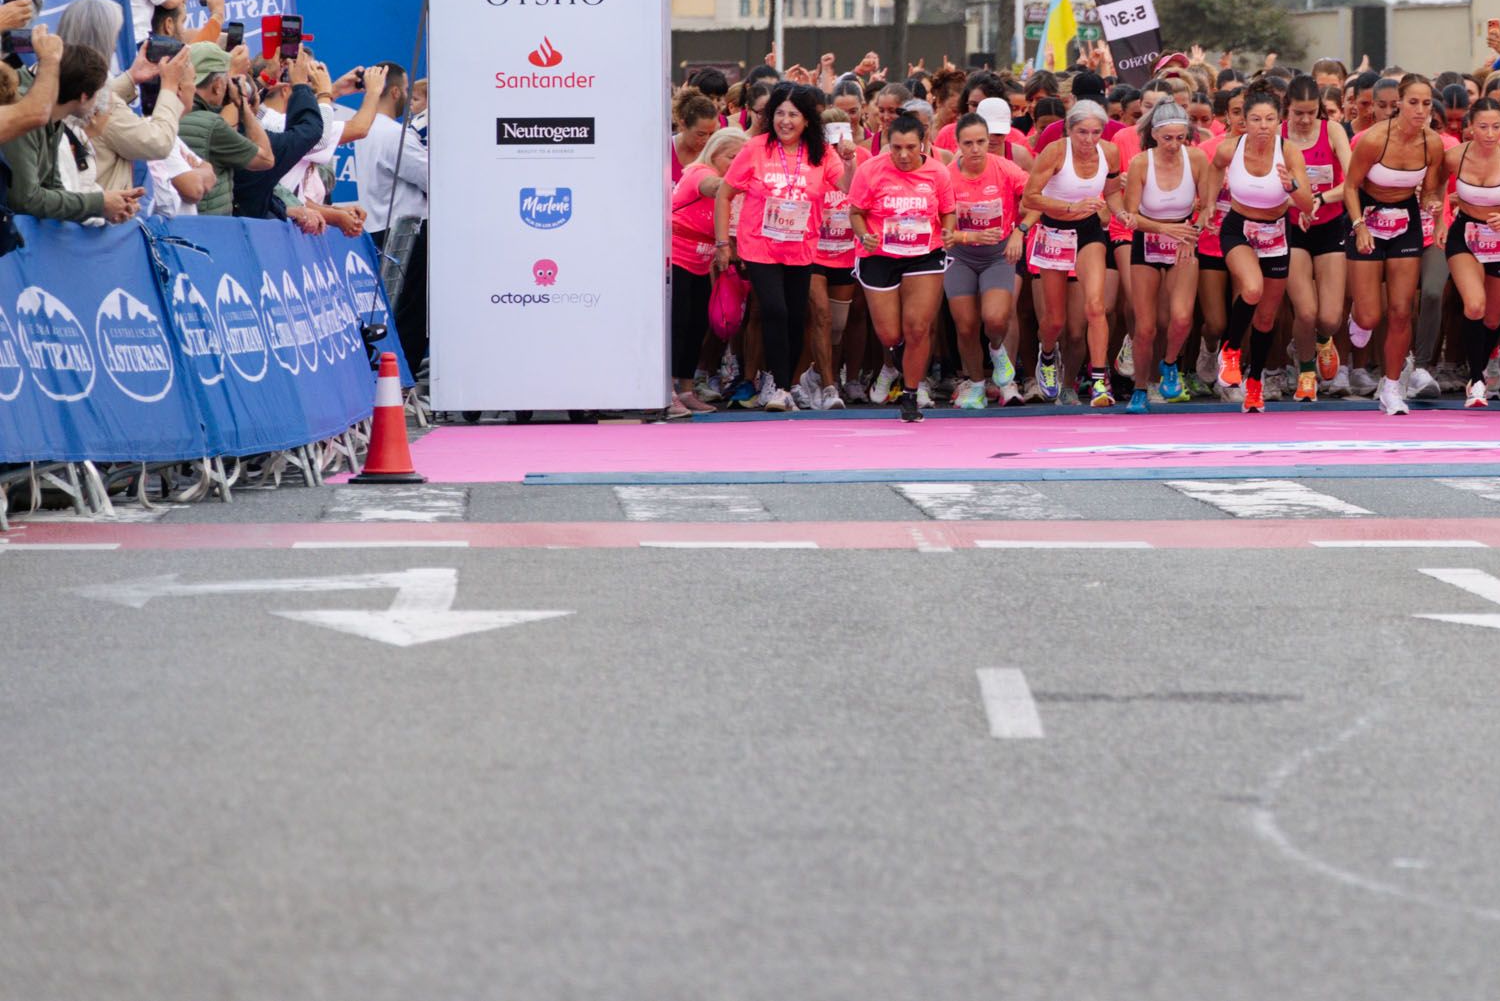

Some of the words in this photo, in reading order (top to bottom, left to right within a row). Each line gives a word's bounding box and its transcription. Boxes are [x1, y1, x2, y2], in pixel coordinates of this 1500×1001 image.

[495, 72, 595, 89] Santander
[502, 123, 589, 142] Neutrogena
[522, 196, 570, 219] Marlene
[883, 196, 928, 210] CARRERA
[778, 217, 795, 226] 016
[1478, 241, 1496, 249] 016
[491, 292, 550, 307] octopus
[551, 292, 601, 307] energy
